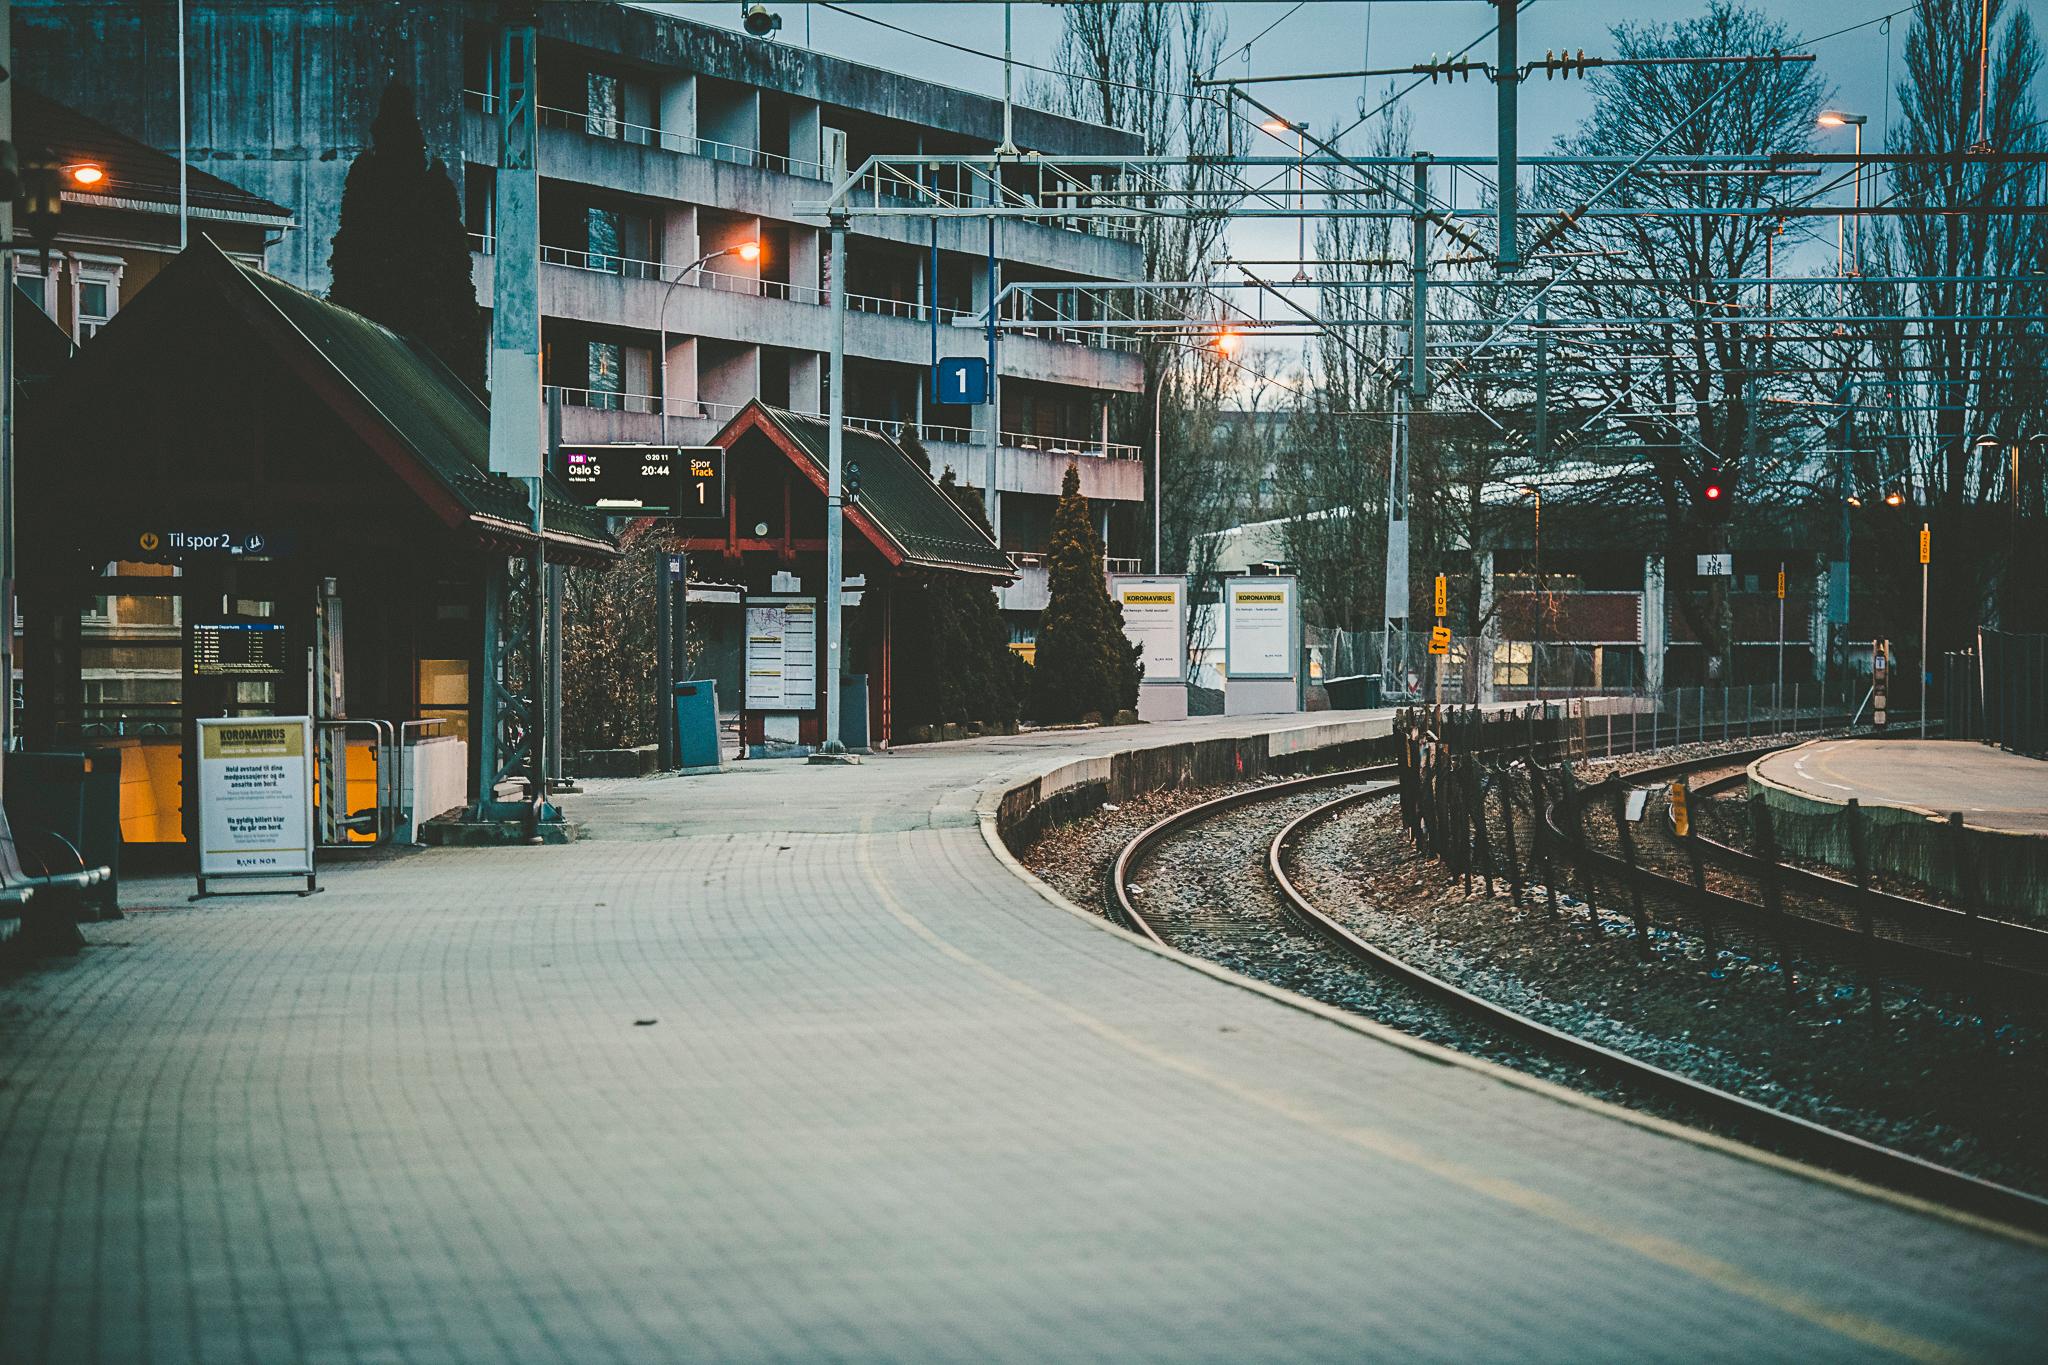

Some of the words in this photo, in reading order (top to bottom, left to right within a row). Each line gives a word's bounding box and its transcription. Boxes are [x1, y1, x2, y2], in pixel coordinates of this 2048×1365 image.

[956, 368, 966, 392] 1
[568, 464, 592, 475] Oslo
[593, 465, 600, 475] S
[690, 459, 710, 470] Spor
[641, 466, 670, 476] 20:44
[691, 468, 714, 477] Track
[696, 482, 705, 504] 1
[168, 532, 184, 547] Til
[187, 536, 219, 550] spor
[221, 534, 230, 547] 2
[220, 728, 286, 740] KORONAVIRUS
[236, 817, 254, 825] gyldig
